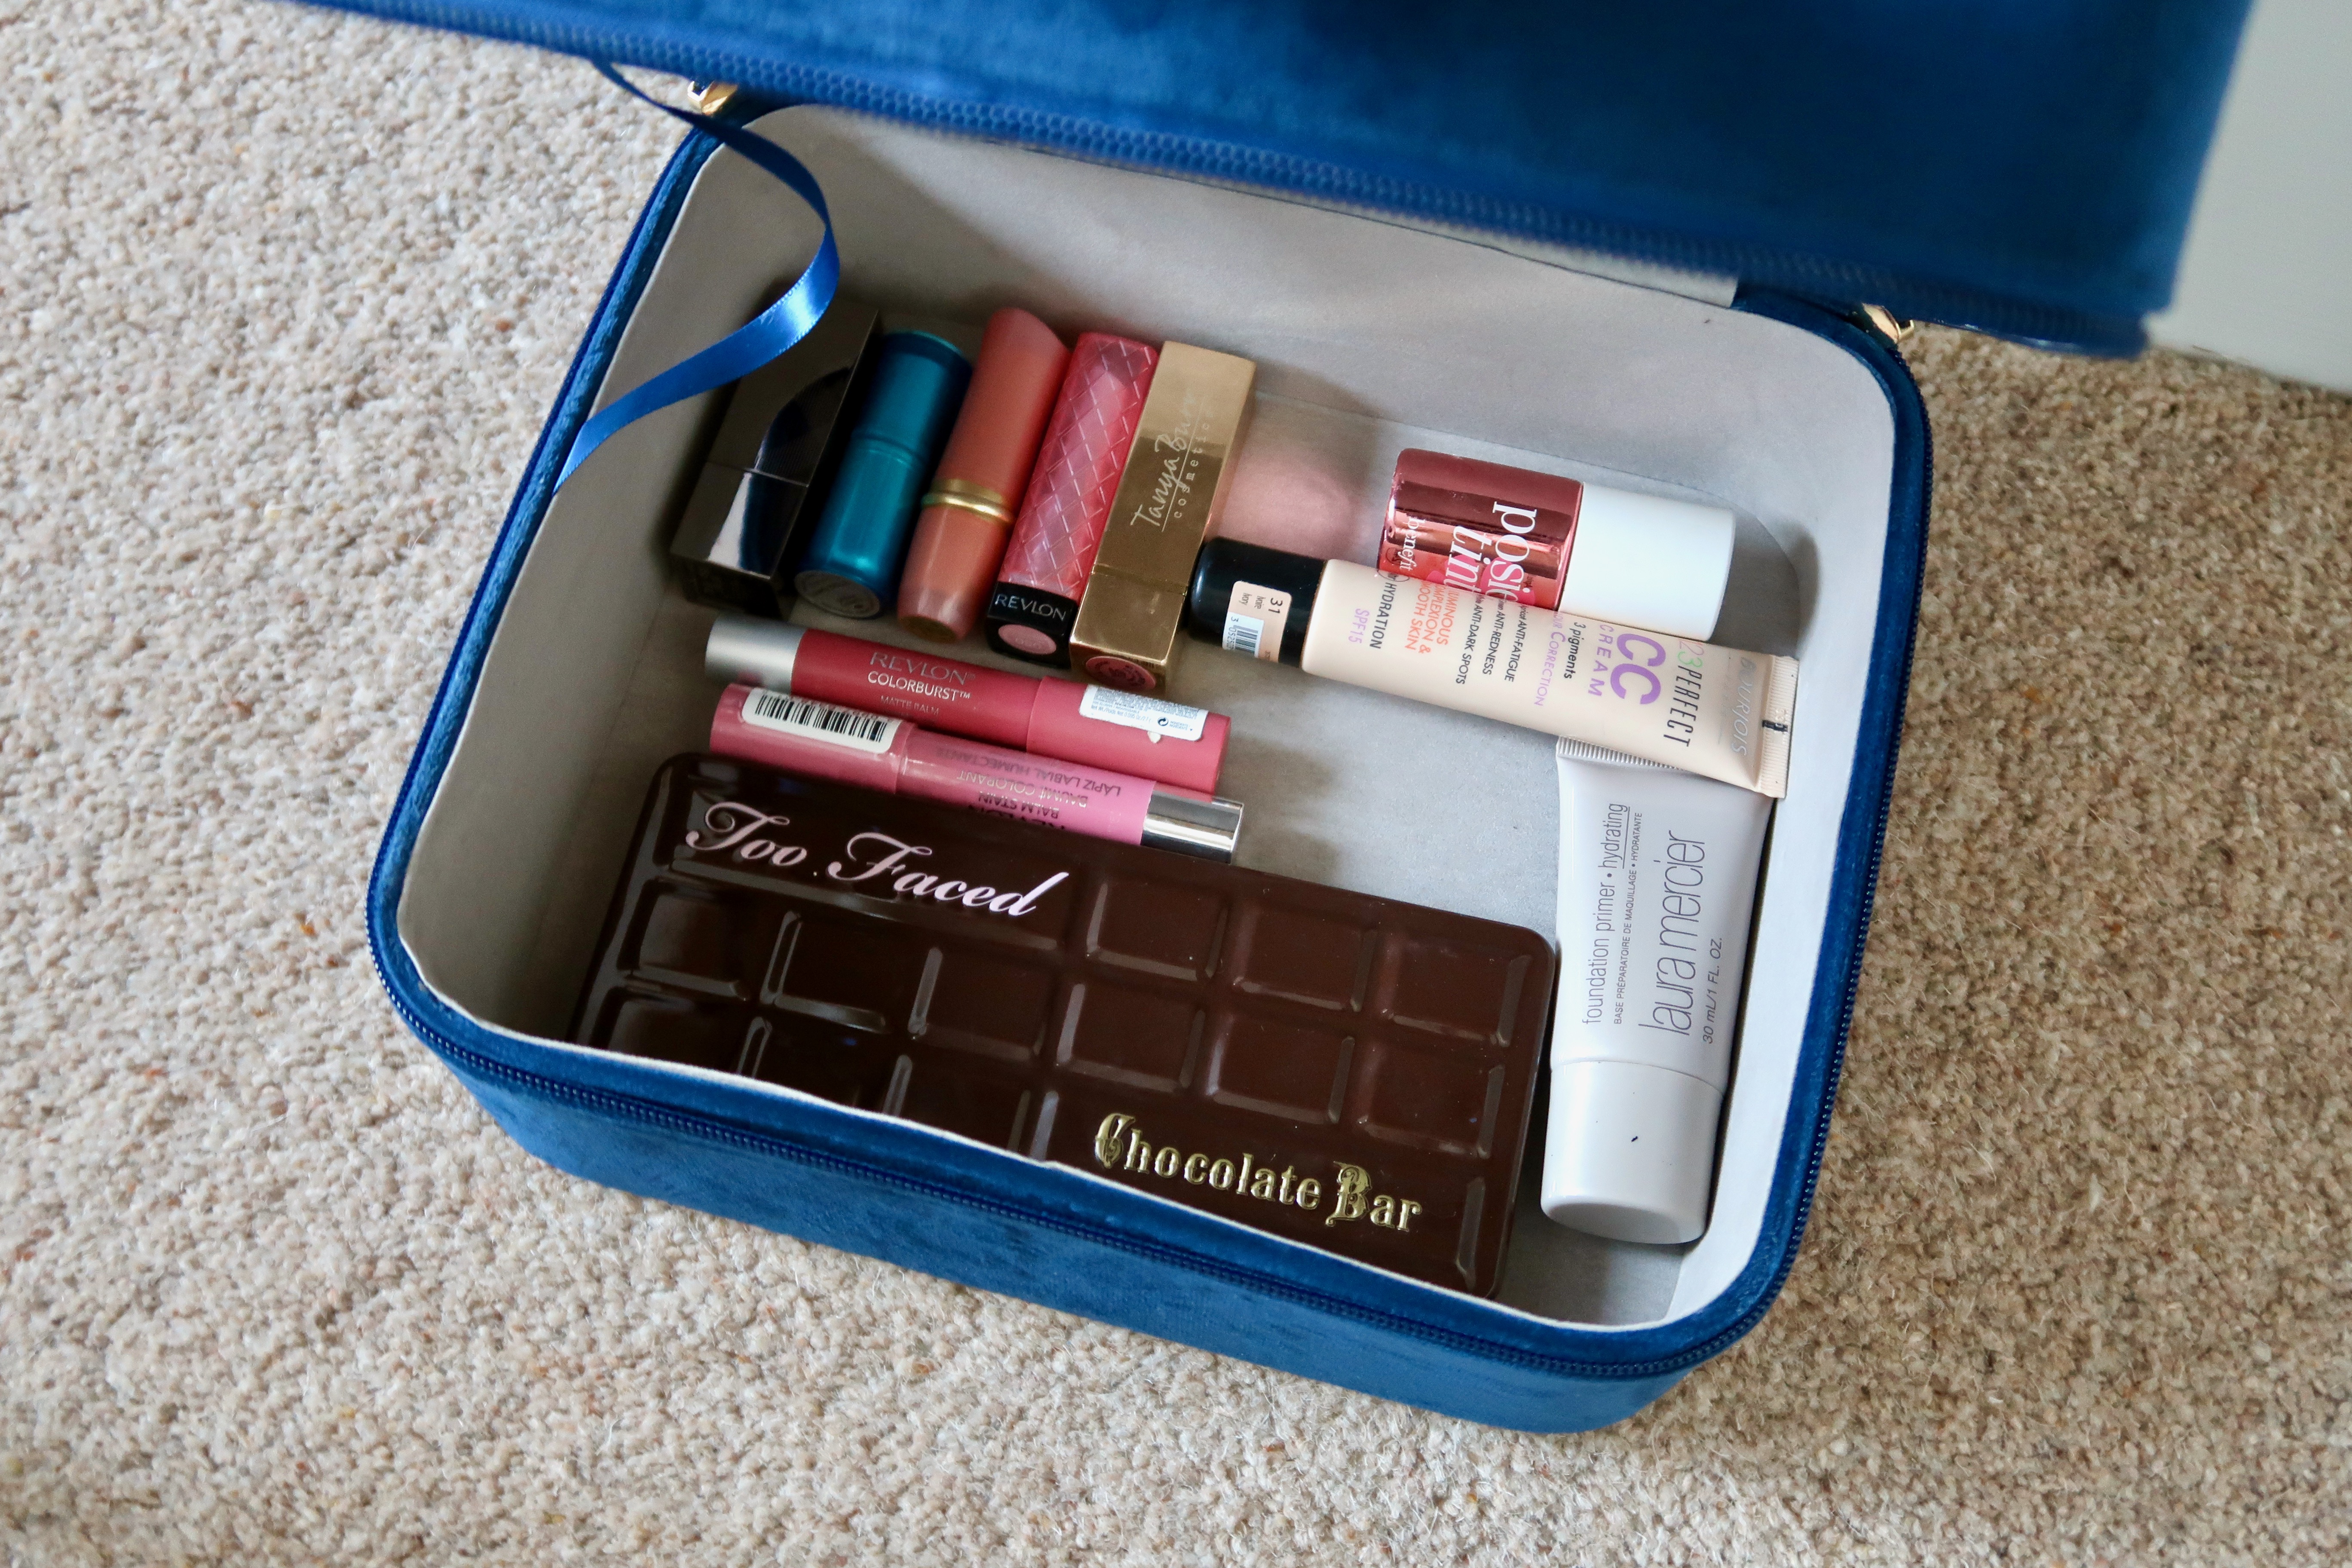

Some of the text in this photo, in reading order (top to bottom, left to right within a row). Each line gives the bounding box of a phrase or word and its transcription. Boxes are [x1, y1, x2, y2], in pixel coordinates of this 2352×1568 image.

[1130, 456, 1187, 526] Tanya
[1398, 516, 1426, 571] benefit
[1443, 526, 1492, 594] tint
[1485, 501, 1537, 602] posie
[994, 594, 1066, 622] REVLON
[1239, 592, 1253, 606] Ivory
[1254, 595, 1266, 609] Ivoire
[1268, 597, 1283, 614] 31
[1369, 582, 1397, 649] HYDRATION
[1404, 581, 1430, 650] MOOTH SKIN
[1418, 585, 1447, 654] OMPLEXION &
[1348, 608, 1370, 644] SPF15
[1464, 604, 1485, 652] ANTI-DARK
[1482, 610, 1506, 675] ANTI-REDNESS
[1504, 620, 1527, 682] ANTI-FATIGUE
[870, 652, 968, 685] REVLON
[1456, 652, 1472, 684] SPOTS
[1534, 631, 1566, 706] CORRECTION
[1564, 628, 1585, 679] pigments
[1588, 624, 1614, 697] CREAM
[1610, 633, 1666, 705] CC
[881, 695, 912, 710] MATTE
[914, 702, 939, 716] BALM
[956, 770, 1088, 808] BAUME COLORANT
[978, 790, 1018, 810] STAIN
[1035, 768, 1081, 787] LABIAL
[1021, 800, 1060, 819] BALM
[685, 801, 1070, 916] Too Faced
[1583, 803, 1628, 1025] foundation primer hydrating
[1614, 812, 1642, 1025] BASE PRÉPARATOIRE DE MAQUILLAGE HYDRATANTE
[1638, 830, 1706, 1036] laura mercier
[1708, 965, 1720, 984] FL.
[1710, 937, 1723, 959] OZ.
[1703, 1026, 1713, 1044] 30
[1094, 1112, 1423, 1232] Chocolate Bar
